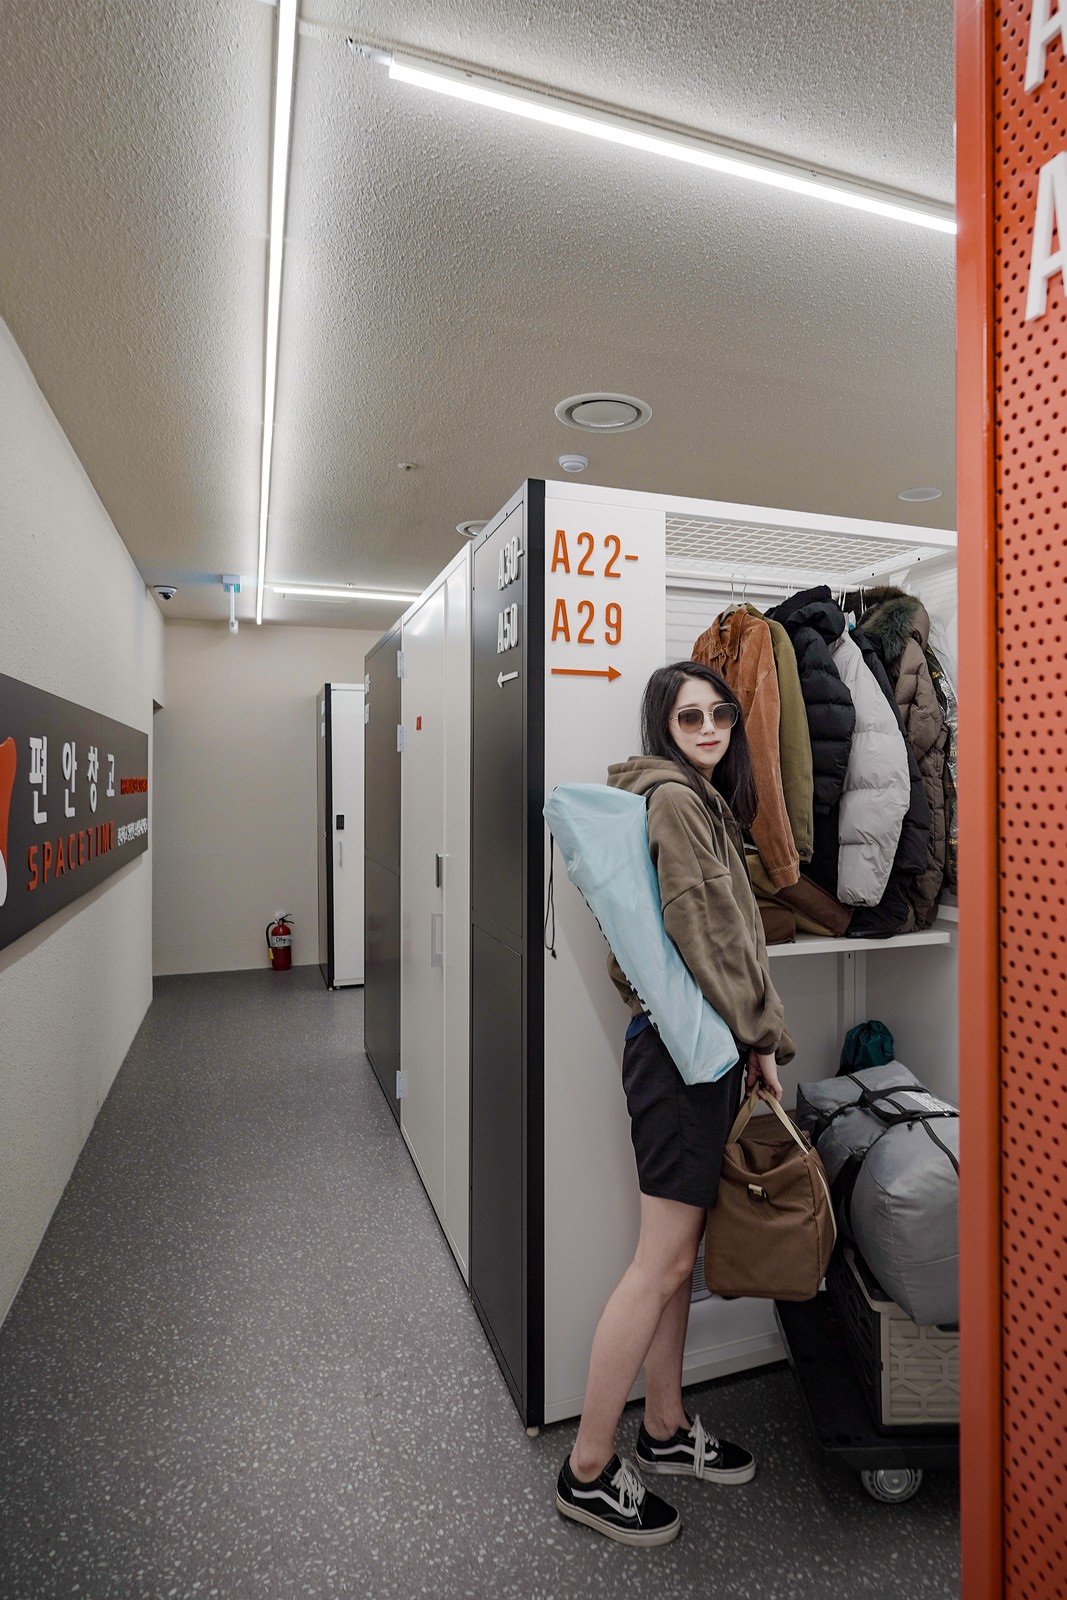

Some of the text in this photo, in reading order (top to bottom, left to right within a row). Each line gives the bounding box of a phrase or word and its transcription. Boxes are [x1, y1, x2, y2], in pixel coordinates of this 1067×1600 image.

[498, 535, 525, 591] A30-
[551, 529, 639, 578] A22-
[497, 602, 518, 654] A50
[551, 598, 622, 646] A29
[28, 735, 116, 825] 편안창고
[27, 821, 115, 891] SPACETIME
